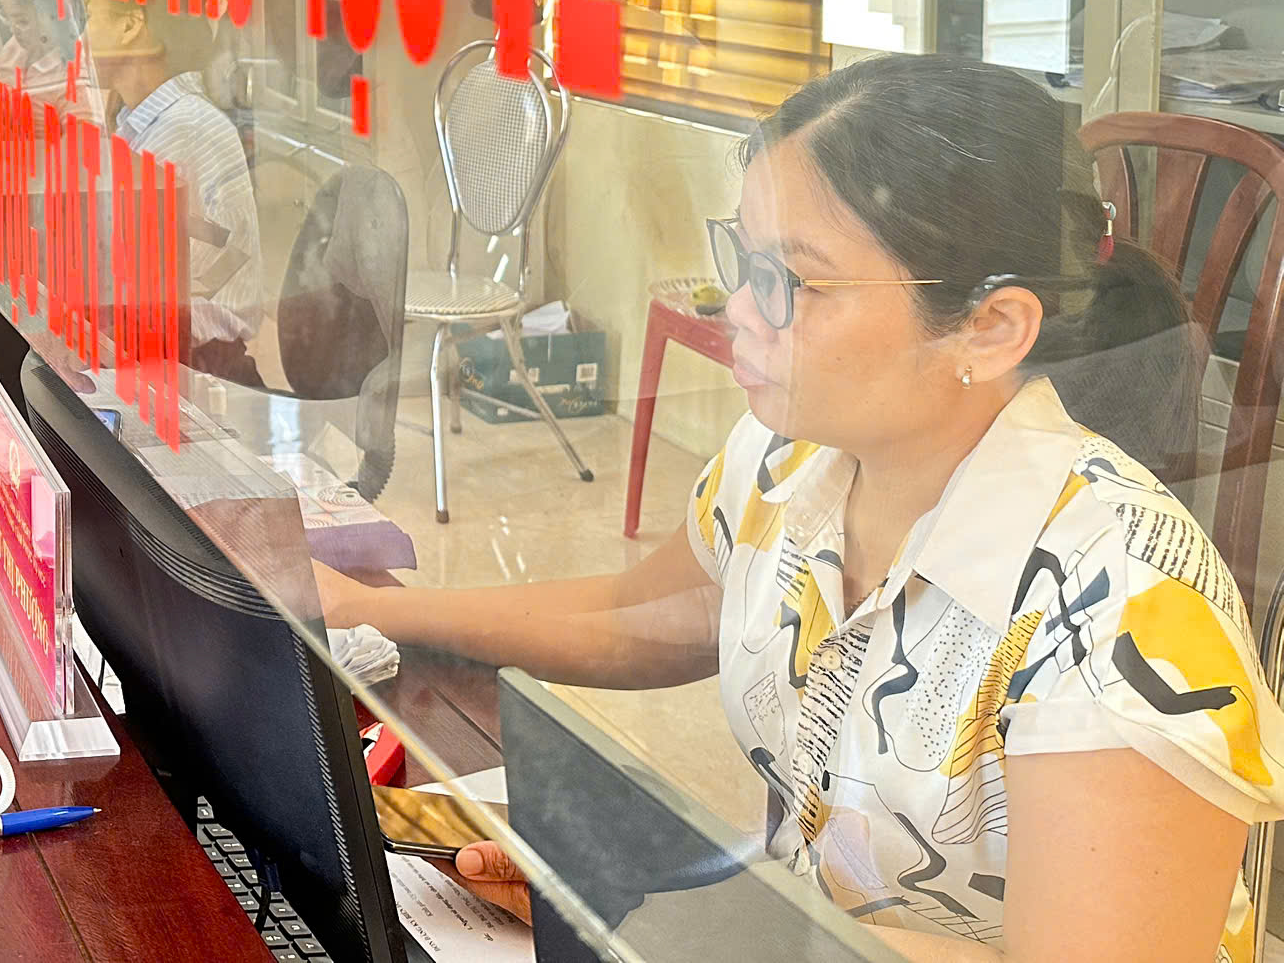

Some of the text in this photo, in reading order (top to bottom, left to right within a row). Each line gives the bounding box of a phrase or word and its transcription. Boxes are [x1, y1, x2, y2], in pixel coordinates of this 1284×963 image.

[111, 133, 181, 455] ĐAI
[3, 537, 14, 597] THỊ
[15, 567, 49, 656] PHƯỢNG
